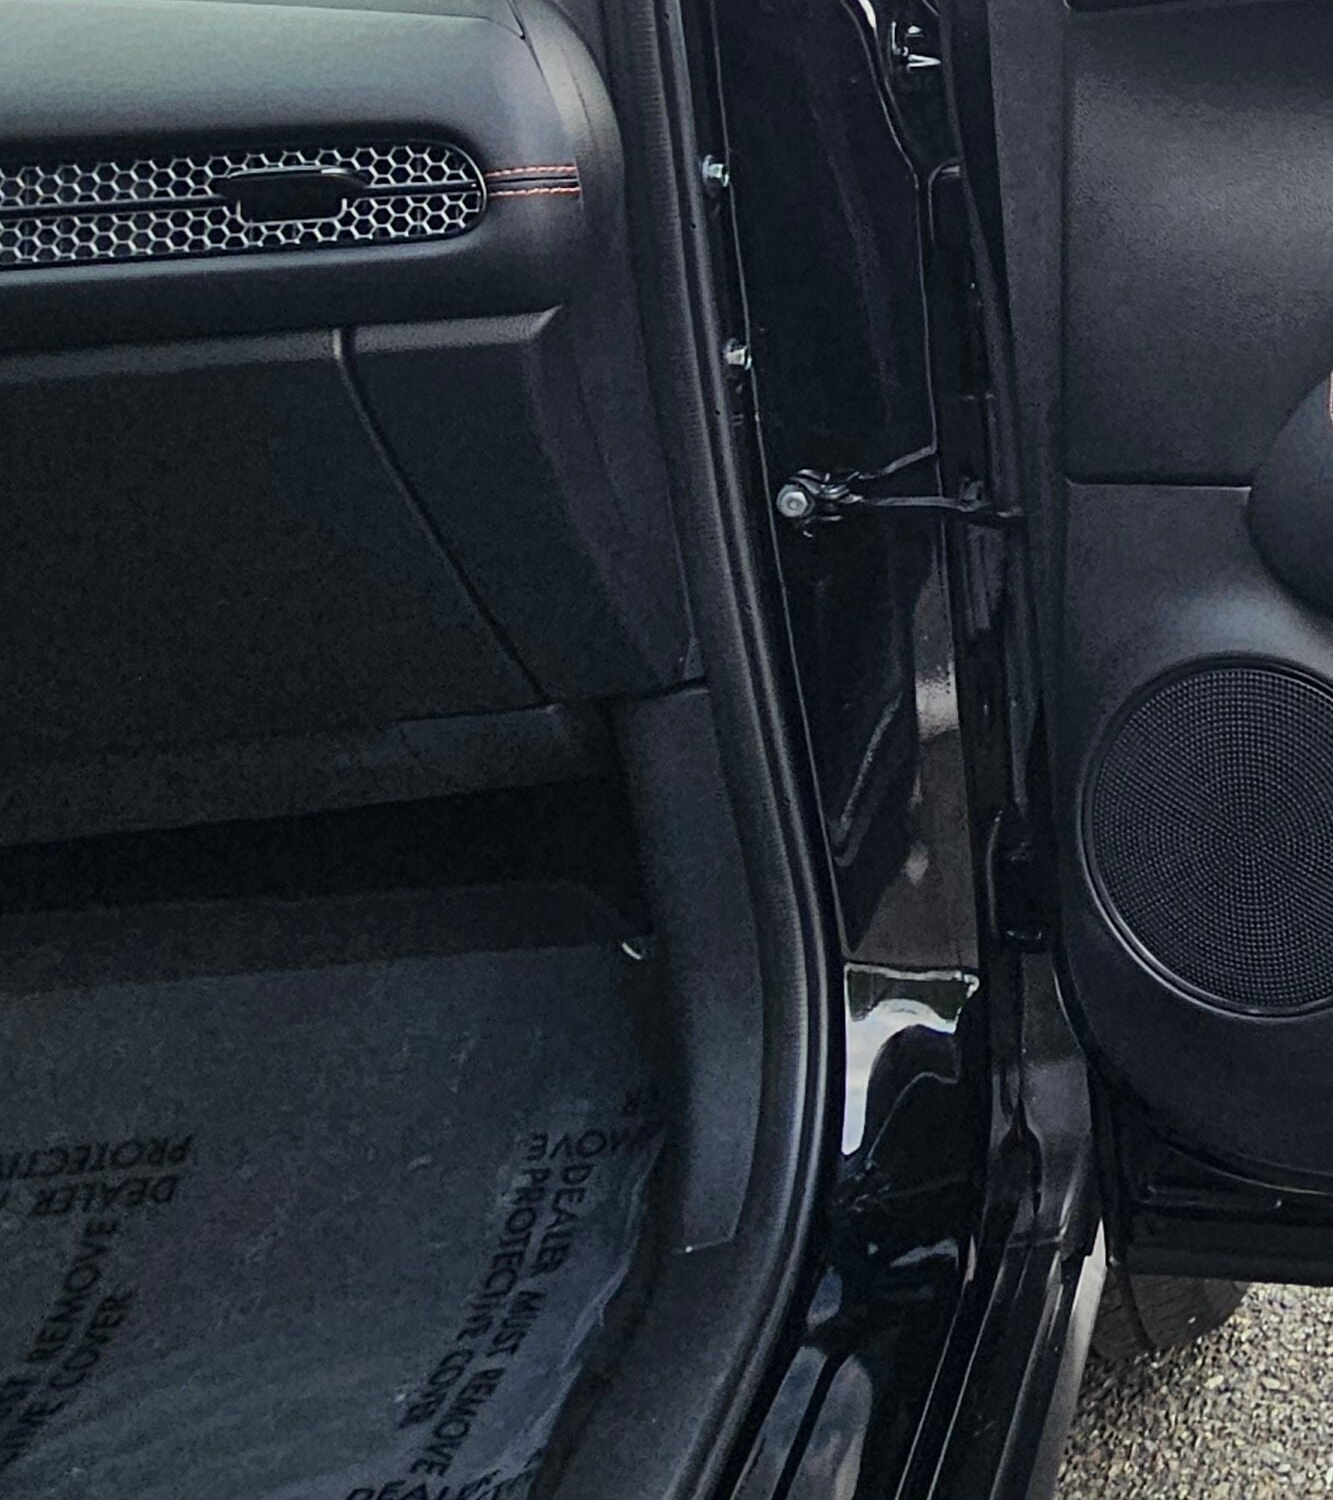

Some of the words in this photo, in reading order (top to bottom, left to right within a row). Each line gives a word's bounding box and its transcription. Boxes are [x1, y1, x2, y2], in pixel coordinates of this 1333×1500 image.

[27, 1175, 178, 1218] DEALER
[530, 1162, 594, 1279] DEALER
[25, 1218, 119, 1363] REMOVE
[486, 1290, 547, 1358] MUST
[409, 1365, 504, 1477] REMOVE
